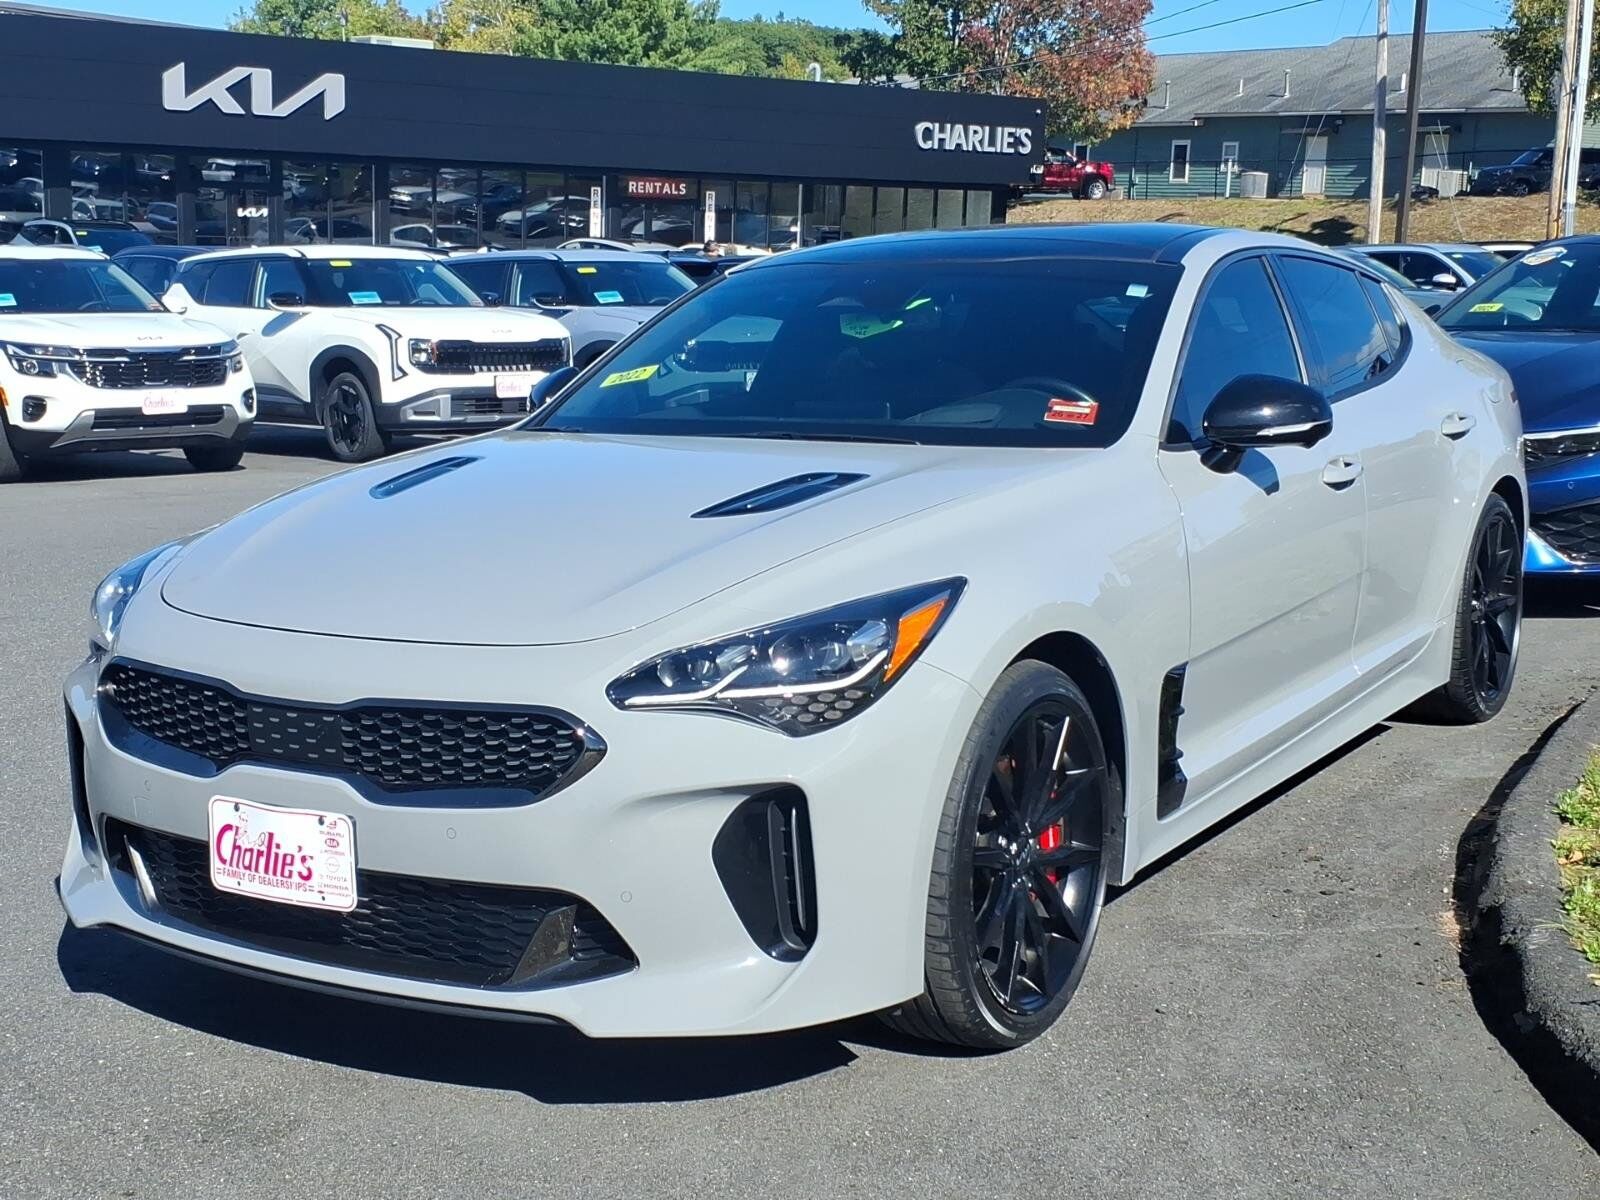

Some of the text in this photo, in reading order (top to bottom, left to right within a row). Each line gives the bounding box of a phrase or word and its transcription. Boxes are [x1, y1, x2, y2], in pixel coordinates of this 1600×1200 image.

[162, 62, 346, 121] KIA
[915, 121, 1032, 154] CHARLIE'S
[628, 181, 687, 195] RENTALS
[237, 207, 269, 218] KIA
[592, 188, 600, 237] RENT
[706, 192, 714, 239] RENT
[216, 823, 314, 882] Charlie's
[223, 867, 246, 880] FAMILY
[248, 873, 257, 882] OF
